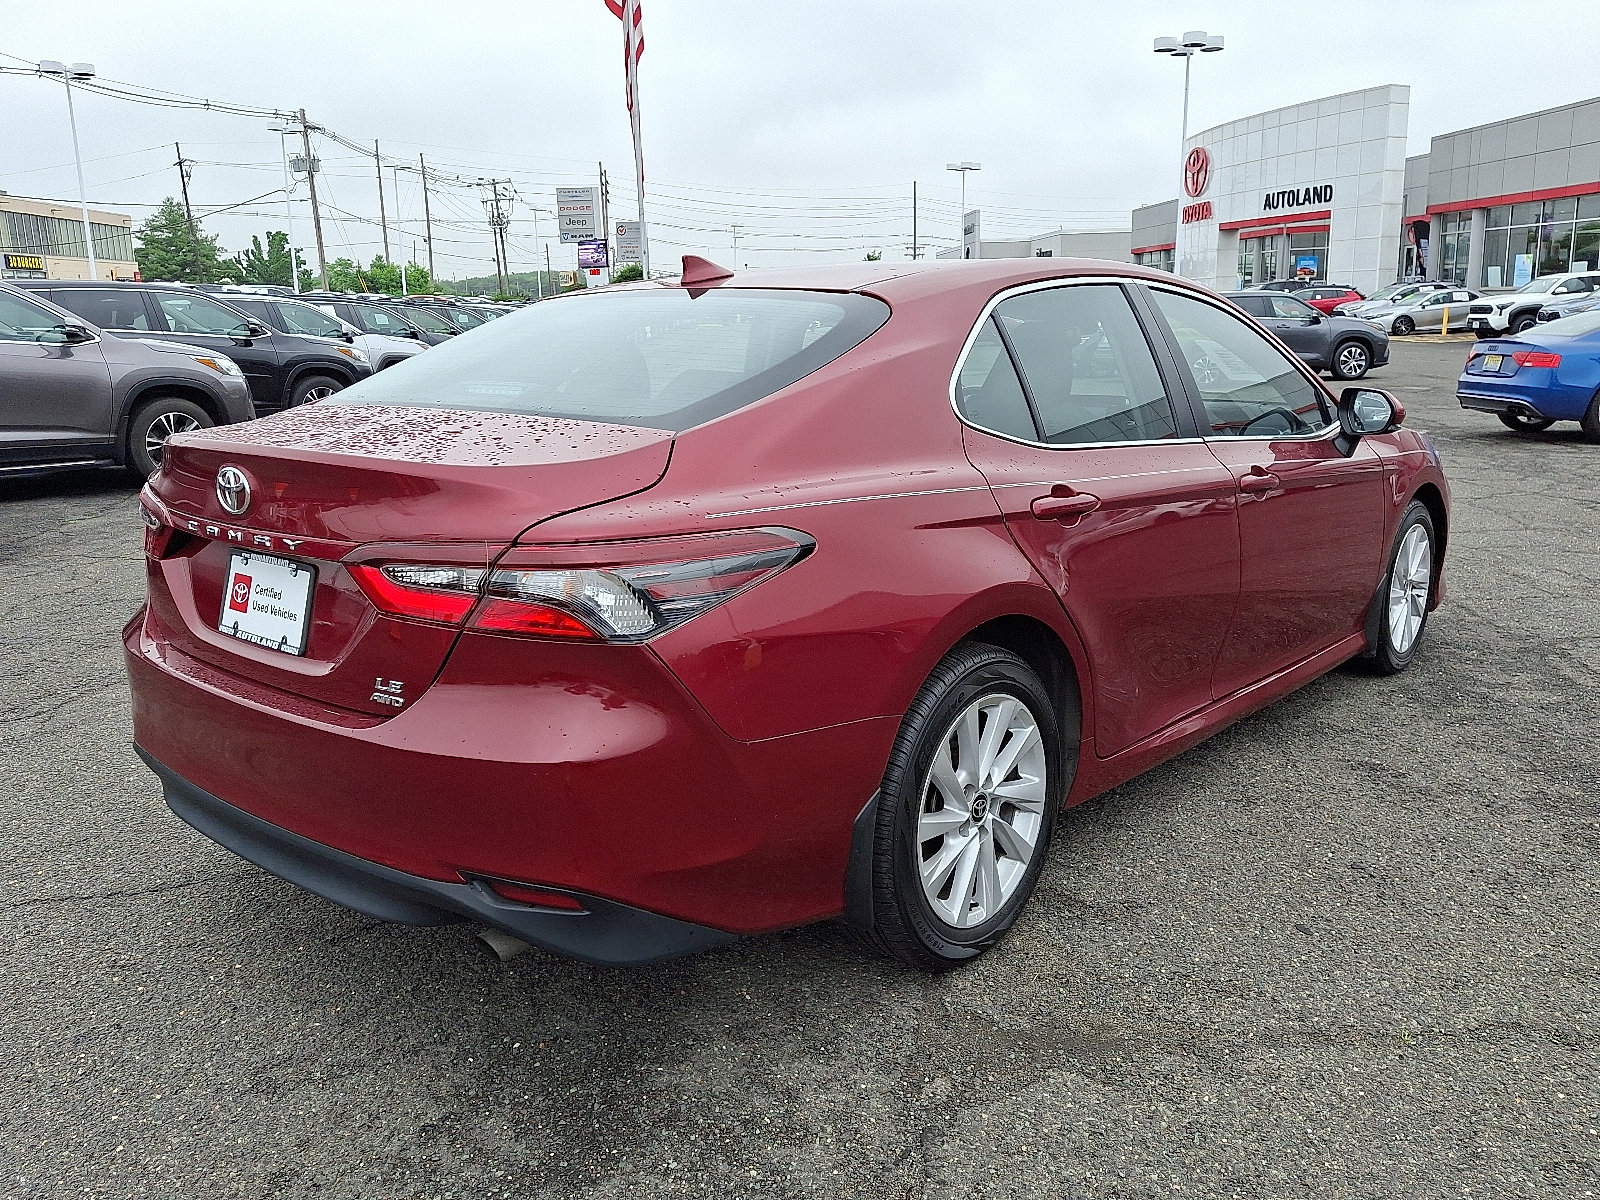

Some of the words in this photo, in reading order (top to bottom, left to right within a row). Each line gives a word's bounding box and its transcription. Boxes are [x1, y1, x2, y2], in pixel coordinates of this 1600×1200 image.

[1263, 184, 1334, 211] AUTOLAND
[1181, 201, 1212, 224] TOYOTA
[565, 217, 587, 226] Jeep
[17, 256, 43, 269] BURGERS
[188, 521, 304, 550] CAMRY
[254, 584, 283, 600] Certified
[252, 600, 270, 614] Used
[270, 603, 298, 622] Vehicles
[236, 630, 279, 649] AUTOLAND
[375, 677, 404, 693] LE
[370, 692, 405, 707] AWD
